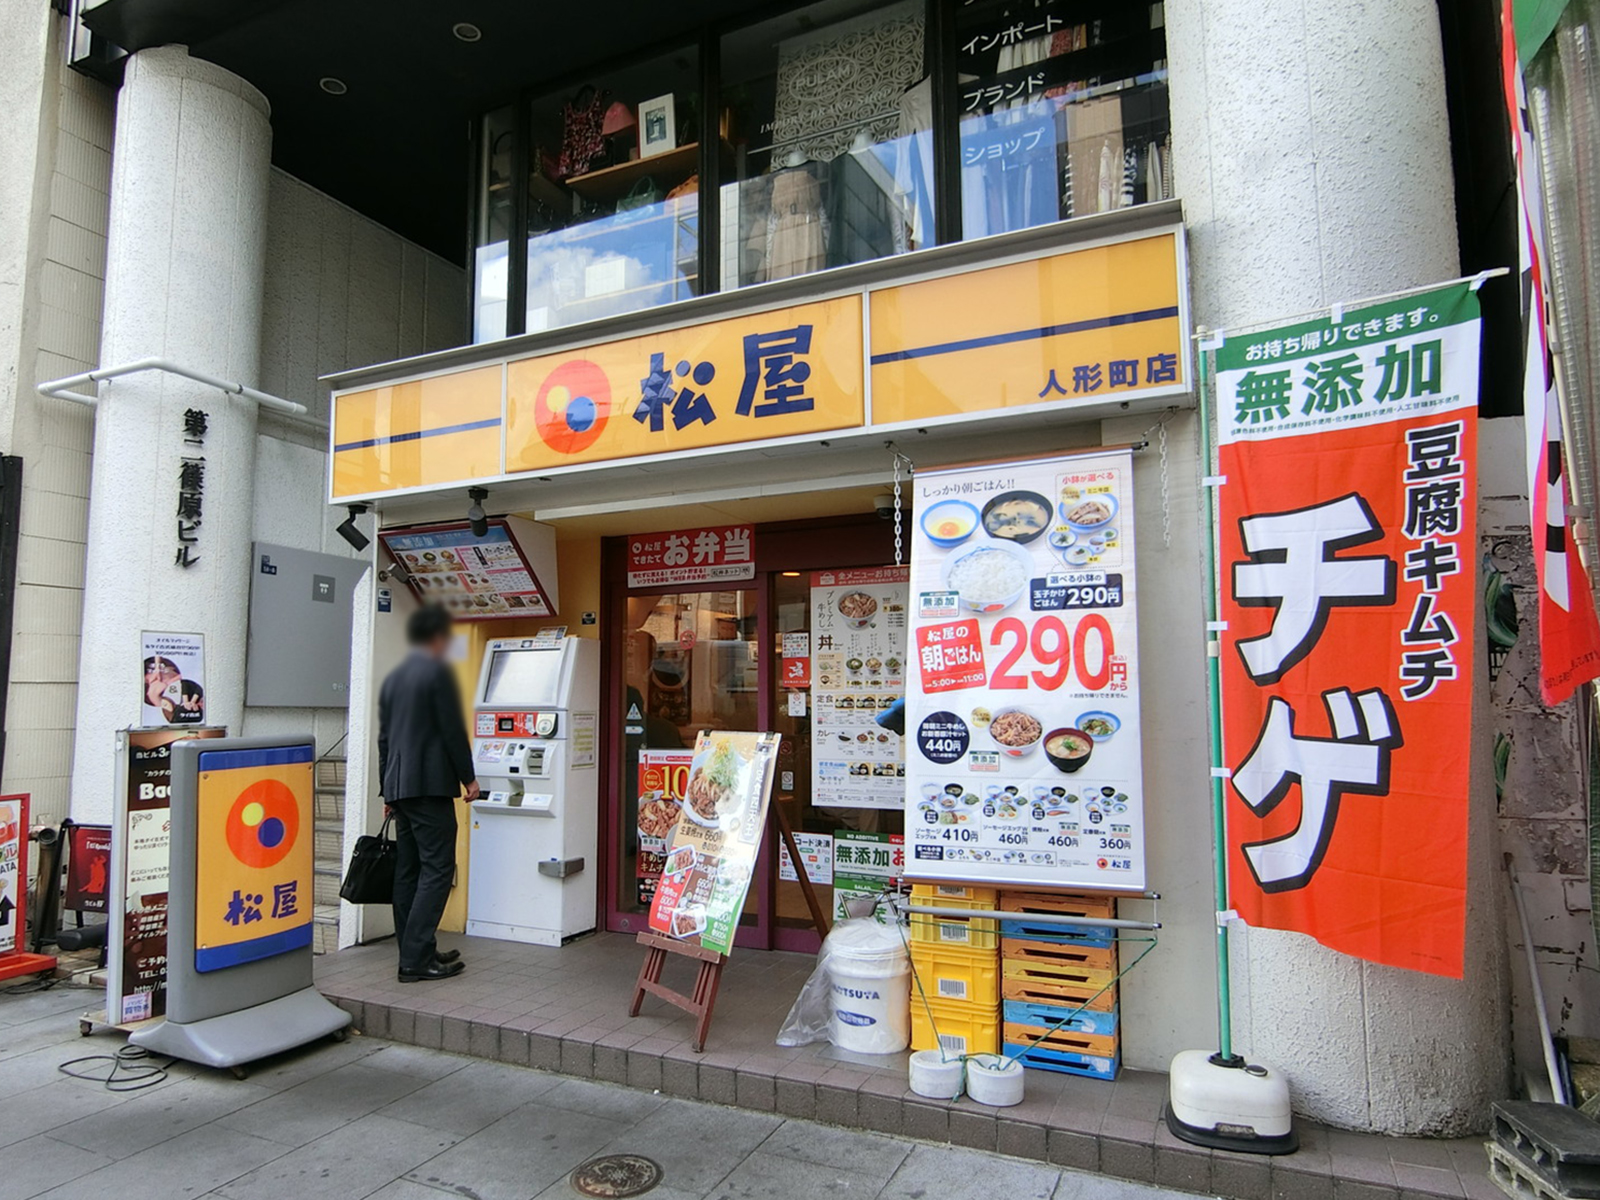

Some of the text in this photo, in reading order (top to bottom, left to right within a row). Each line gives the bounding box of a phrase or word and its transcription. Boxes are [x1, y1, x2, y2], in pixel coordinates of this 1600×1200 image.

[962, 14, 1063, 55] インポート
[963, 72, 1045, 112] ブランド
[965, 127, 1045, 165] ショップ
[1244, 306, 1440, 362] お持ち帰りできます。
[633, 325, 815, 432] 松屋
[1038, 353, 1178, 399] 人形町店
[1234, 338, 1443, 425] 無添加
[1062, 473, 1115, 484] 小鉢が選べる
[663, 528, 750, 566] お弁当
[1401, 420, 1464, 701] 豆腐キムチ
[1033, 586, 1120, 606] 玉子かけ 290円
[1050, 574, 1102, 584] 選べる小鉢の
[818, 634, 834, 651] 丼
[927, 626, 969, 642] 松屋の
[921, 643, 981, 673] 朝ごはん
[1231, 493, 1403, 894] チゲ
[925, 739, 961, 752] 440円
[836, 844, 890, 867] 無添加
[223, 879, 298, 927] 松屋
